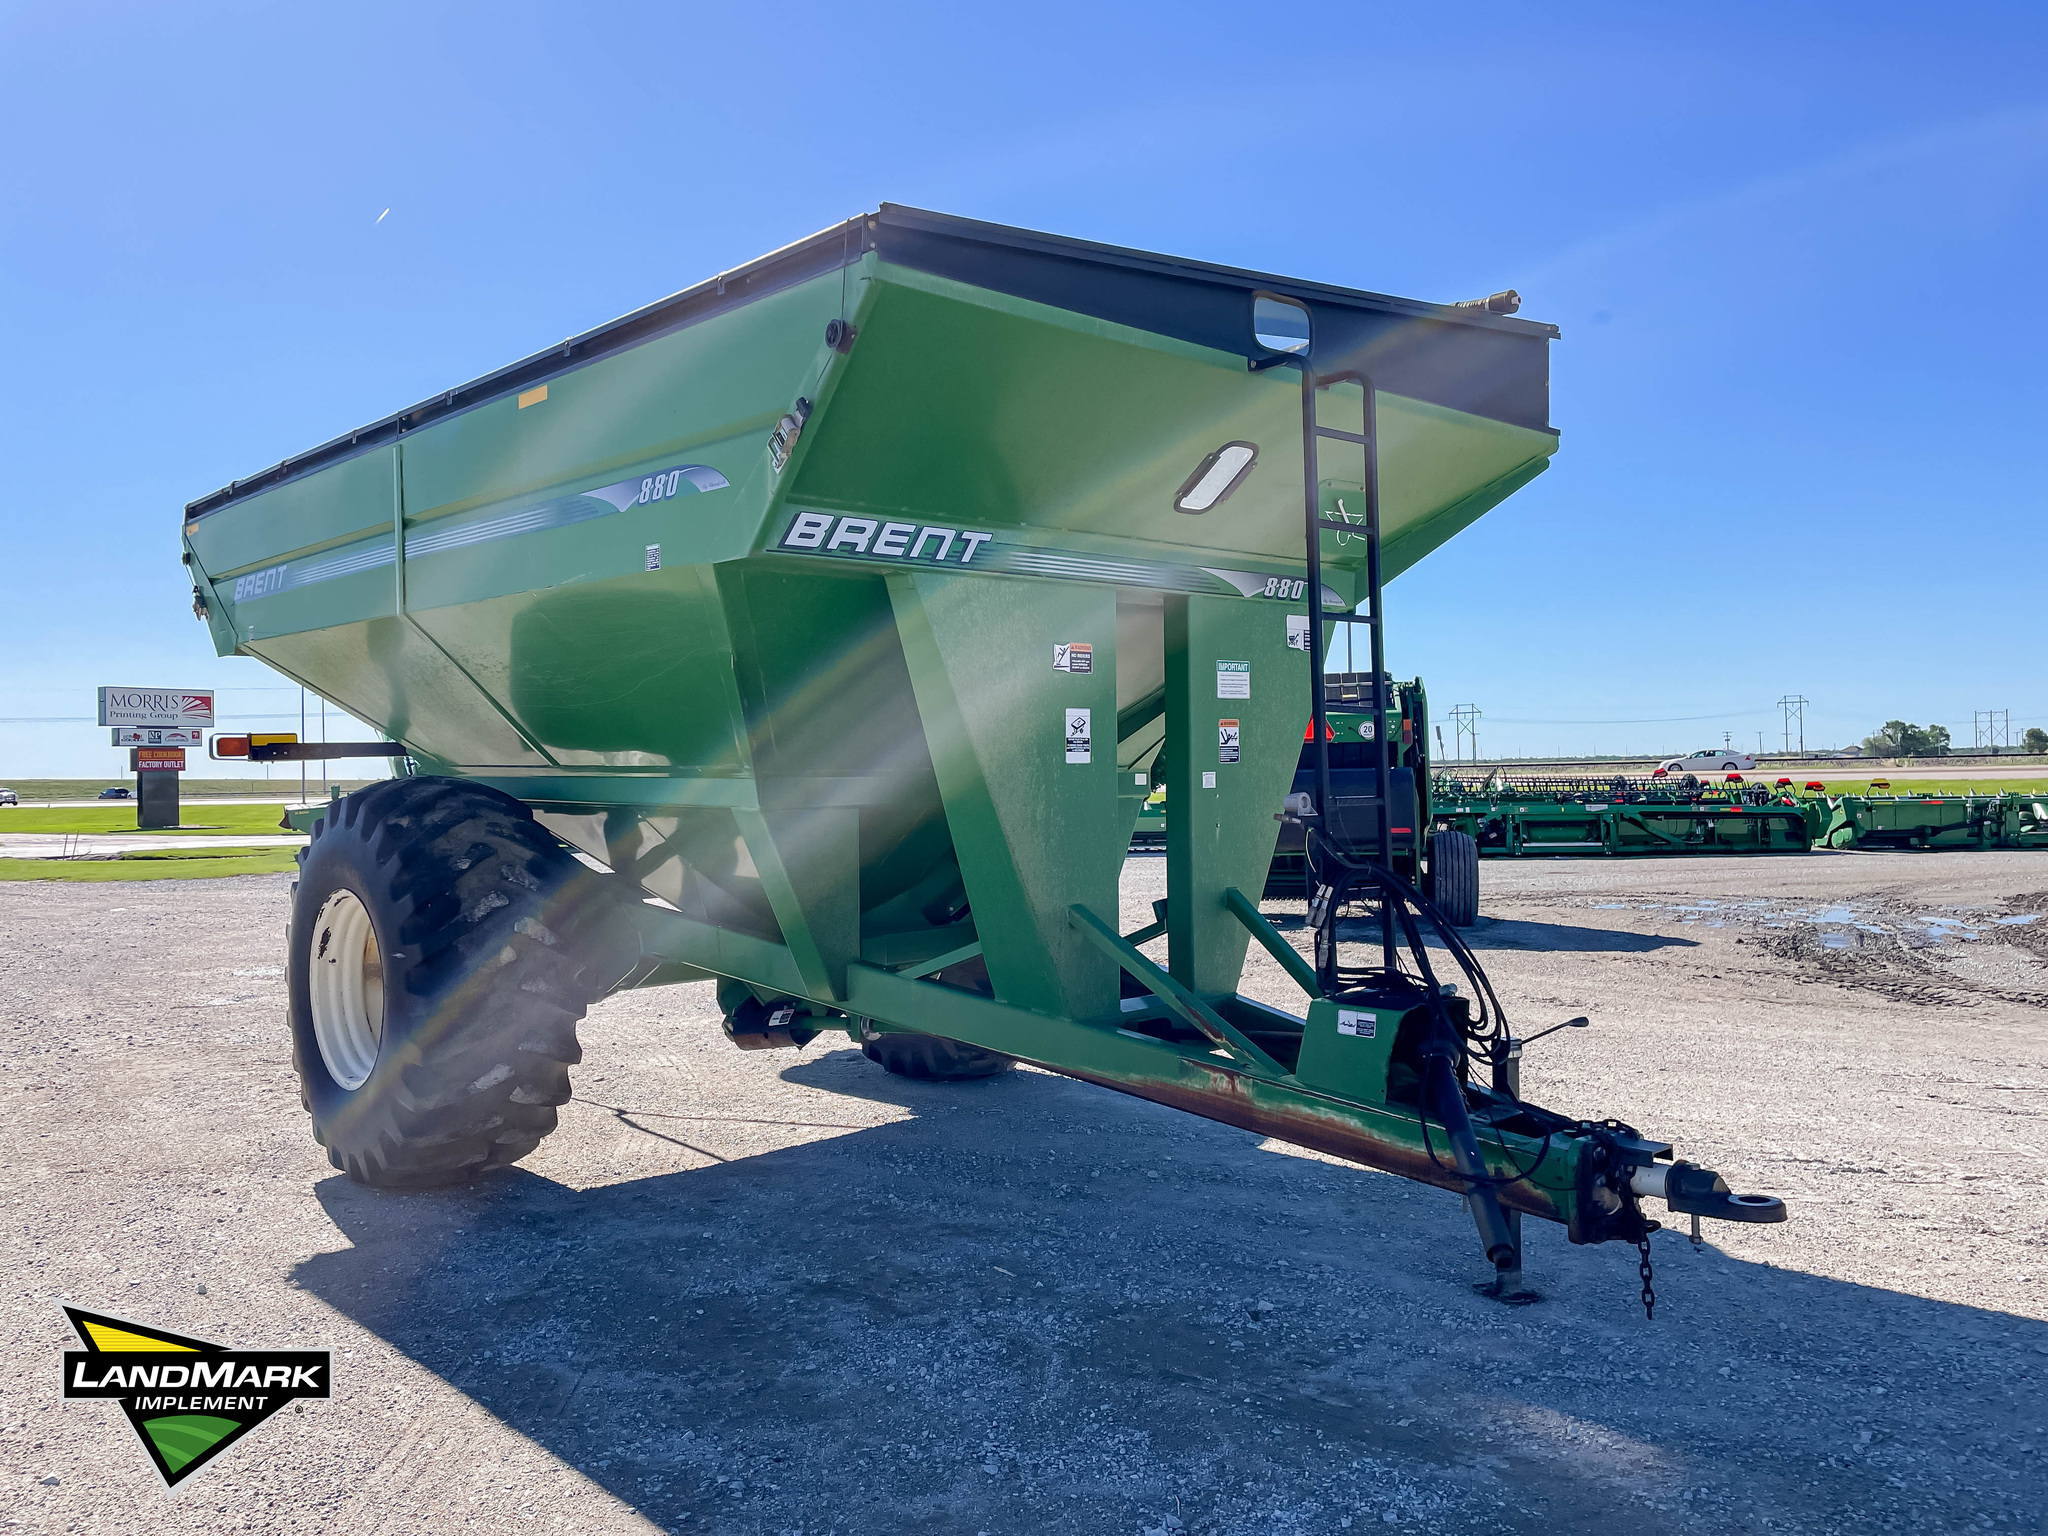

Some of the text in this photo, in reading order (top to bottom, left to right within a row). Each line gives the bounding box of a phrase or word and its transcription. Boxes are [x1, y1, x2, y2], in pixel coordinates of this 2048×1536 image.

[638, 470, 681, 504] 880
[782, 511, 994, 563] BRENT
[233, 564, 288, 601] BRENT
[1263, 577, 1305, 600] 880
[1218, 662, 1249, 672] IMPORTANT
[110, 693, 179, 712] MORRIS
[109, 710, 179, 720] Printing Group
[1363, 725, 1373, 733] 20
[138, 760, 184, 768] FACTORY OUTLET
